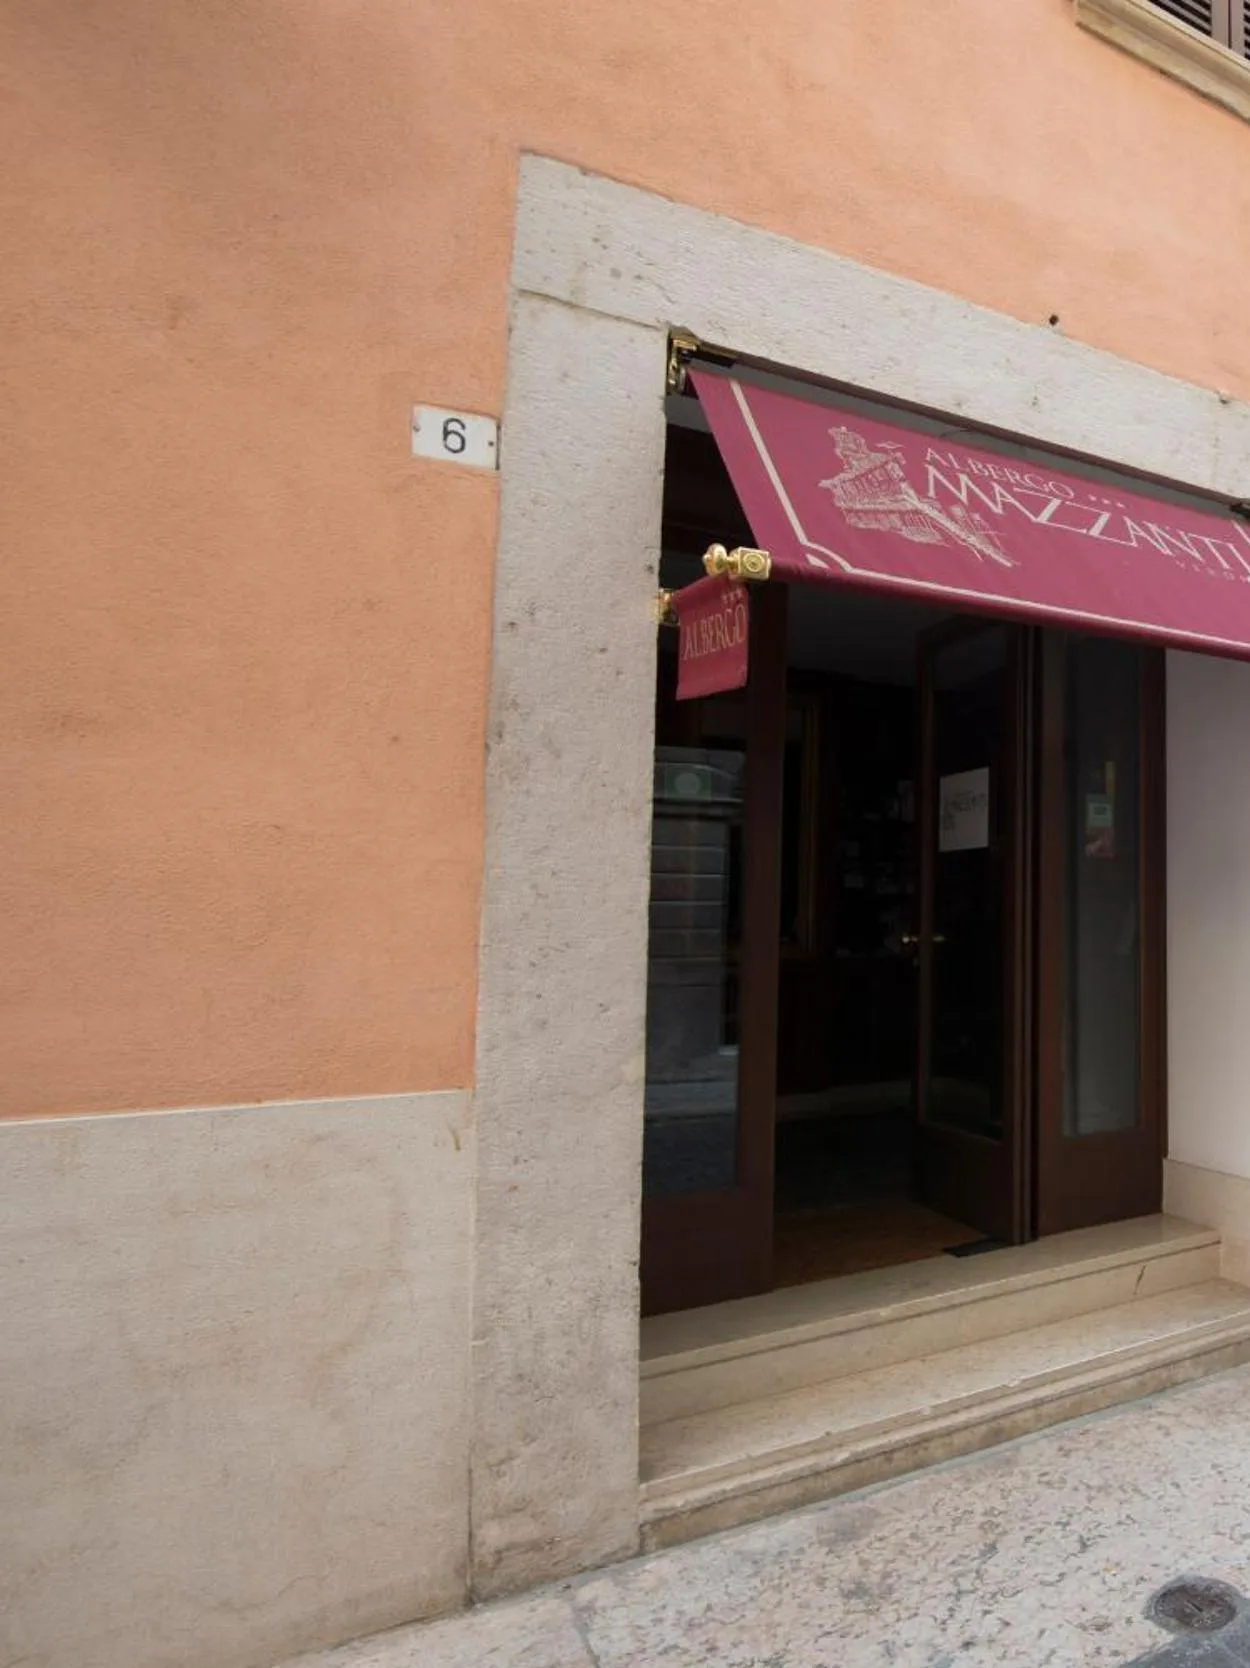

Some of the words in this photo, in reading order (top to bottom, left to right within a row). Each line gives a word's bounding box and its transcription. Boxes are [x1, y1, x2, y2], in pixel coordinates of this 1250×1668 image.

[443, 417, 466, 454] 6
[926, 448, 1074, 499] ALBERGO
[683, 603, 746, 661] ALBERGO
